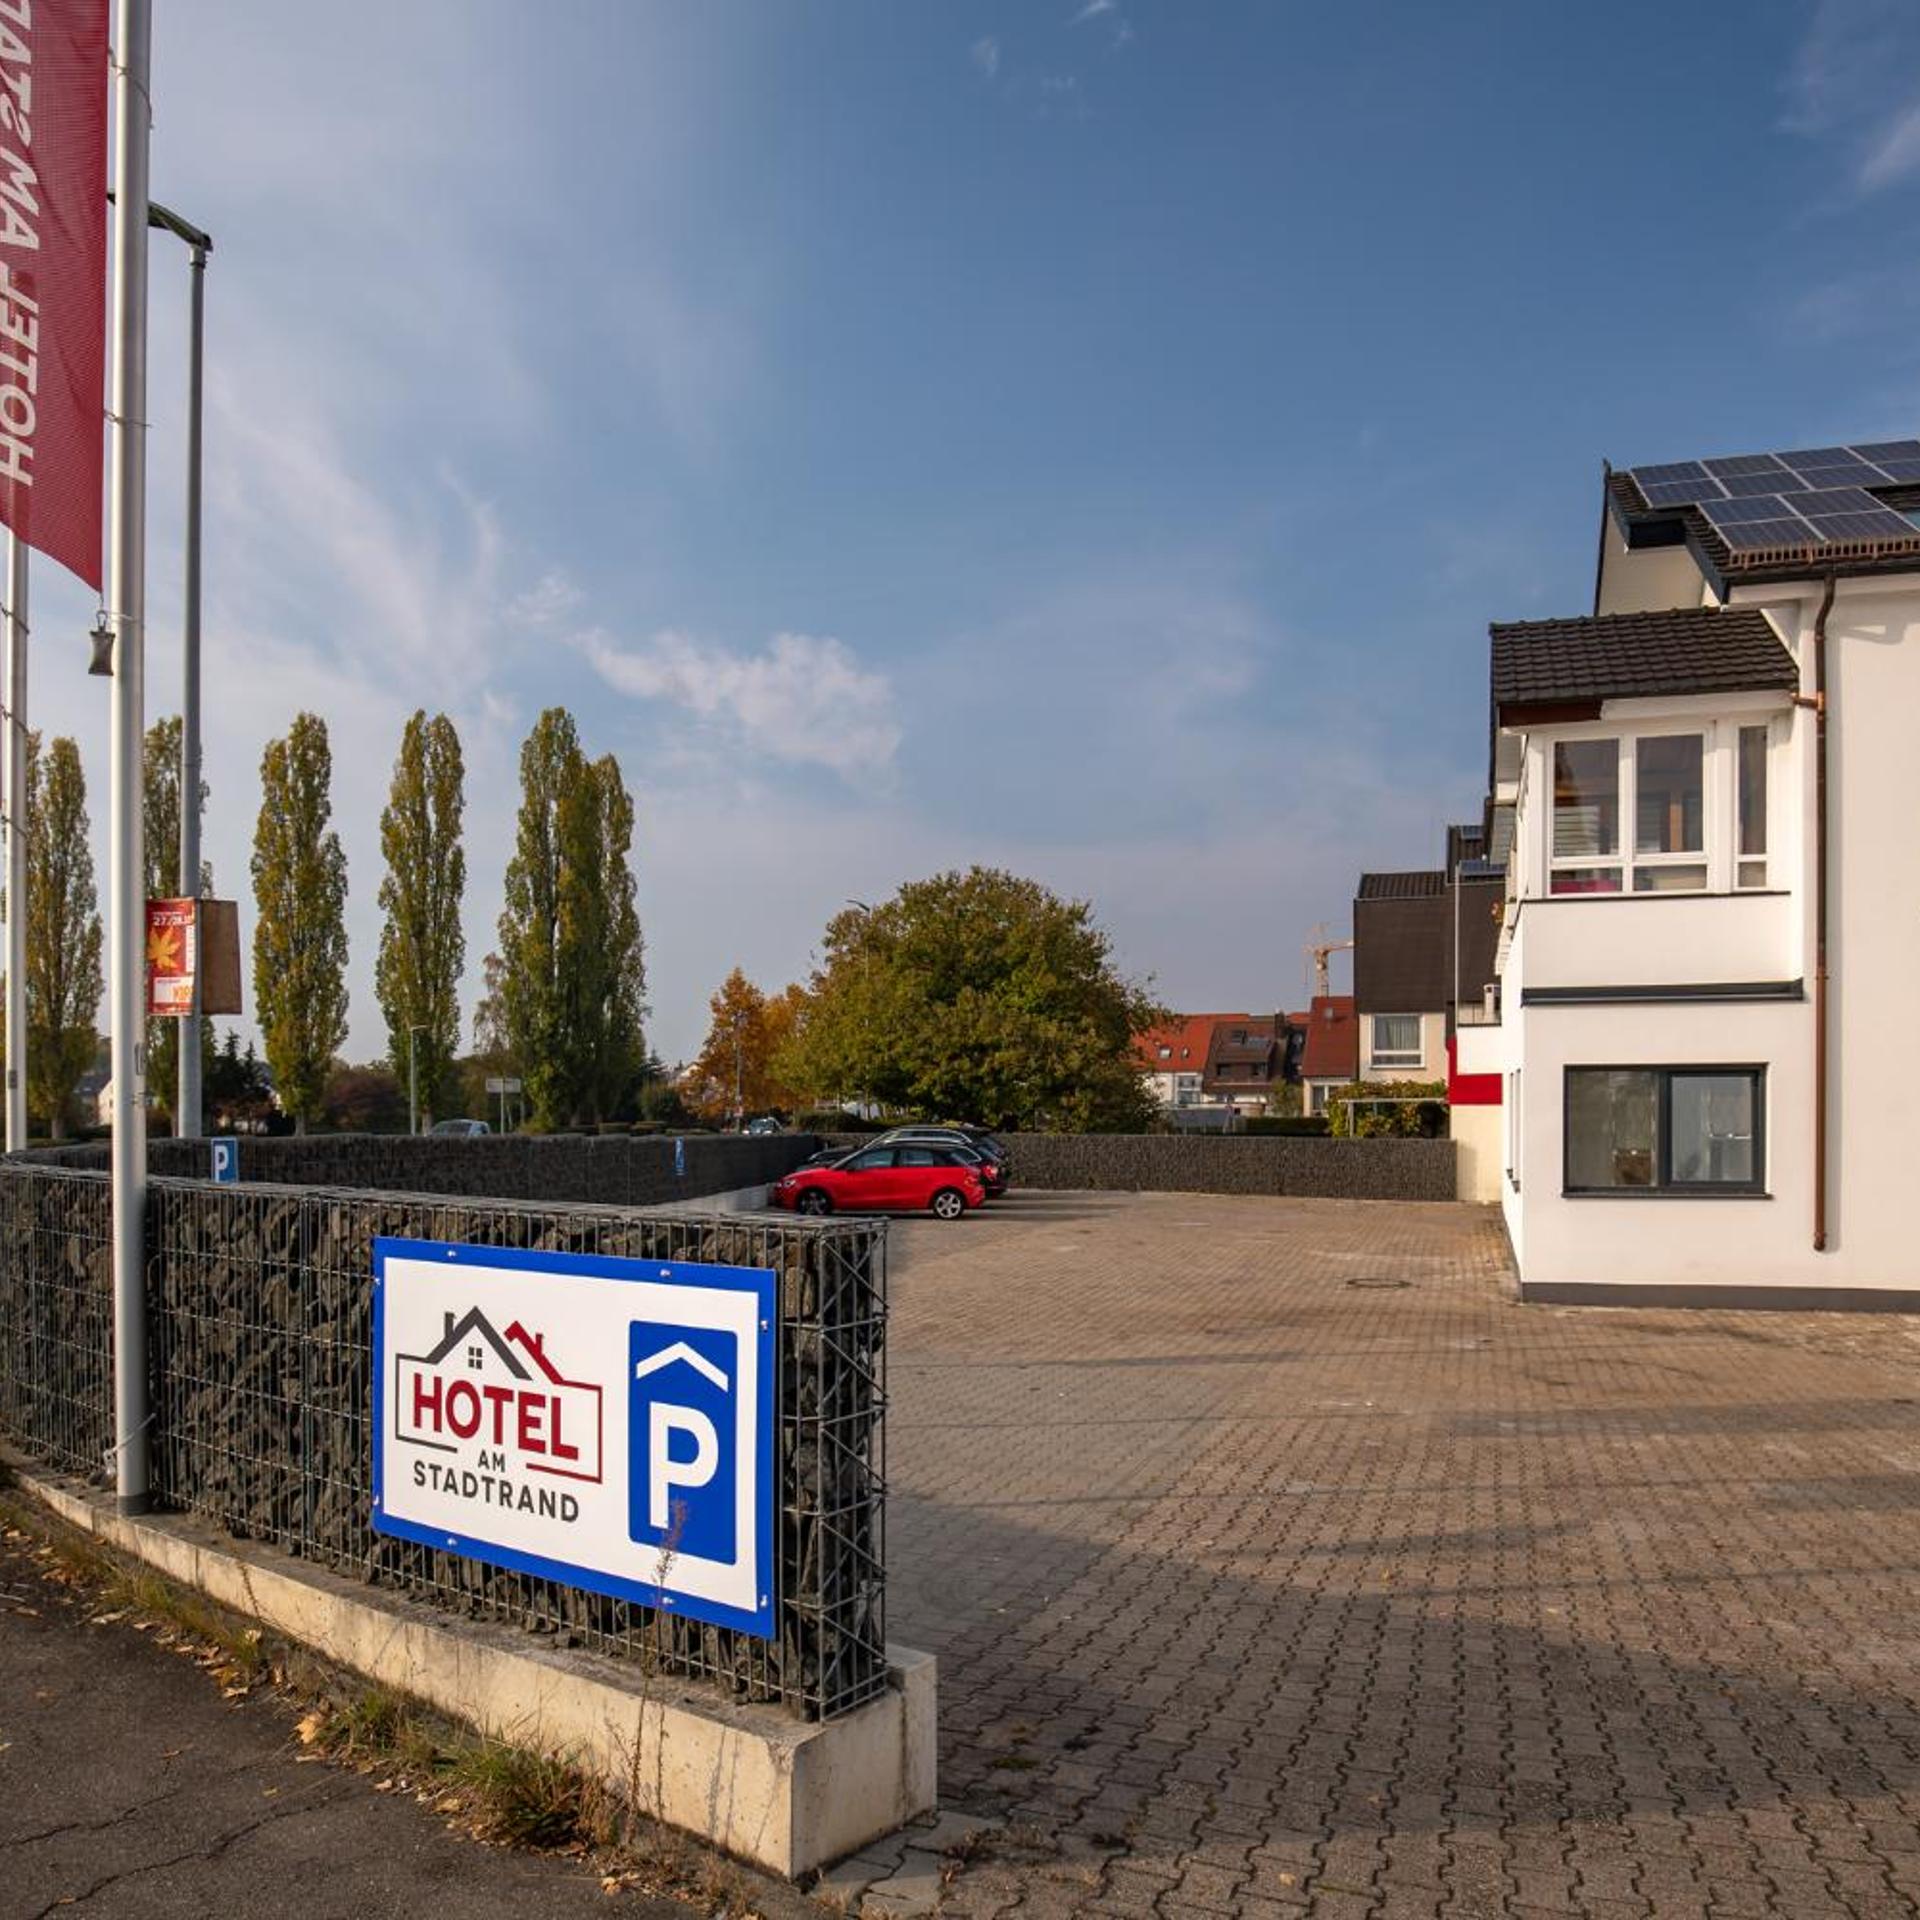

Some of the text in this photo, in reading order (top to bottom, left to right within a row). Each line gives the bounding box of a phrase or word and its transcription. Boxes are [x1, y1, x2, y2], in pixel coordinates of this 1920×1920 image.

[214, 1145, 229, 1184] P
[413, 1372, 579, 1461] HOTEL
[413, 1460, 580, 1523] STADTRAND
[478, 1450, 506, 1473] AM
[649, 1401, 719, 1530] P
